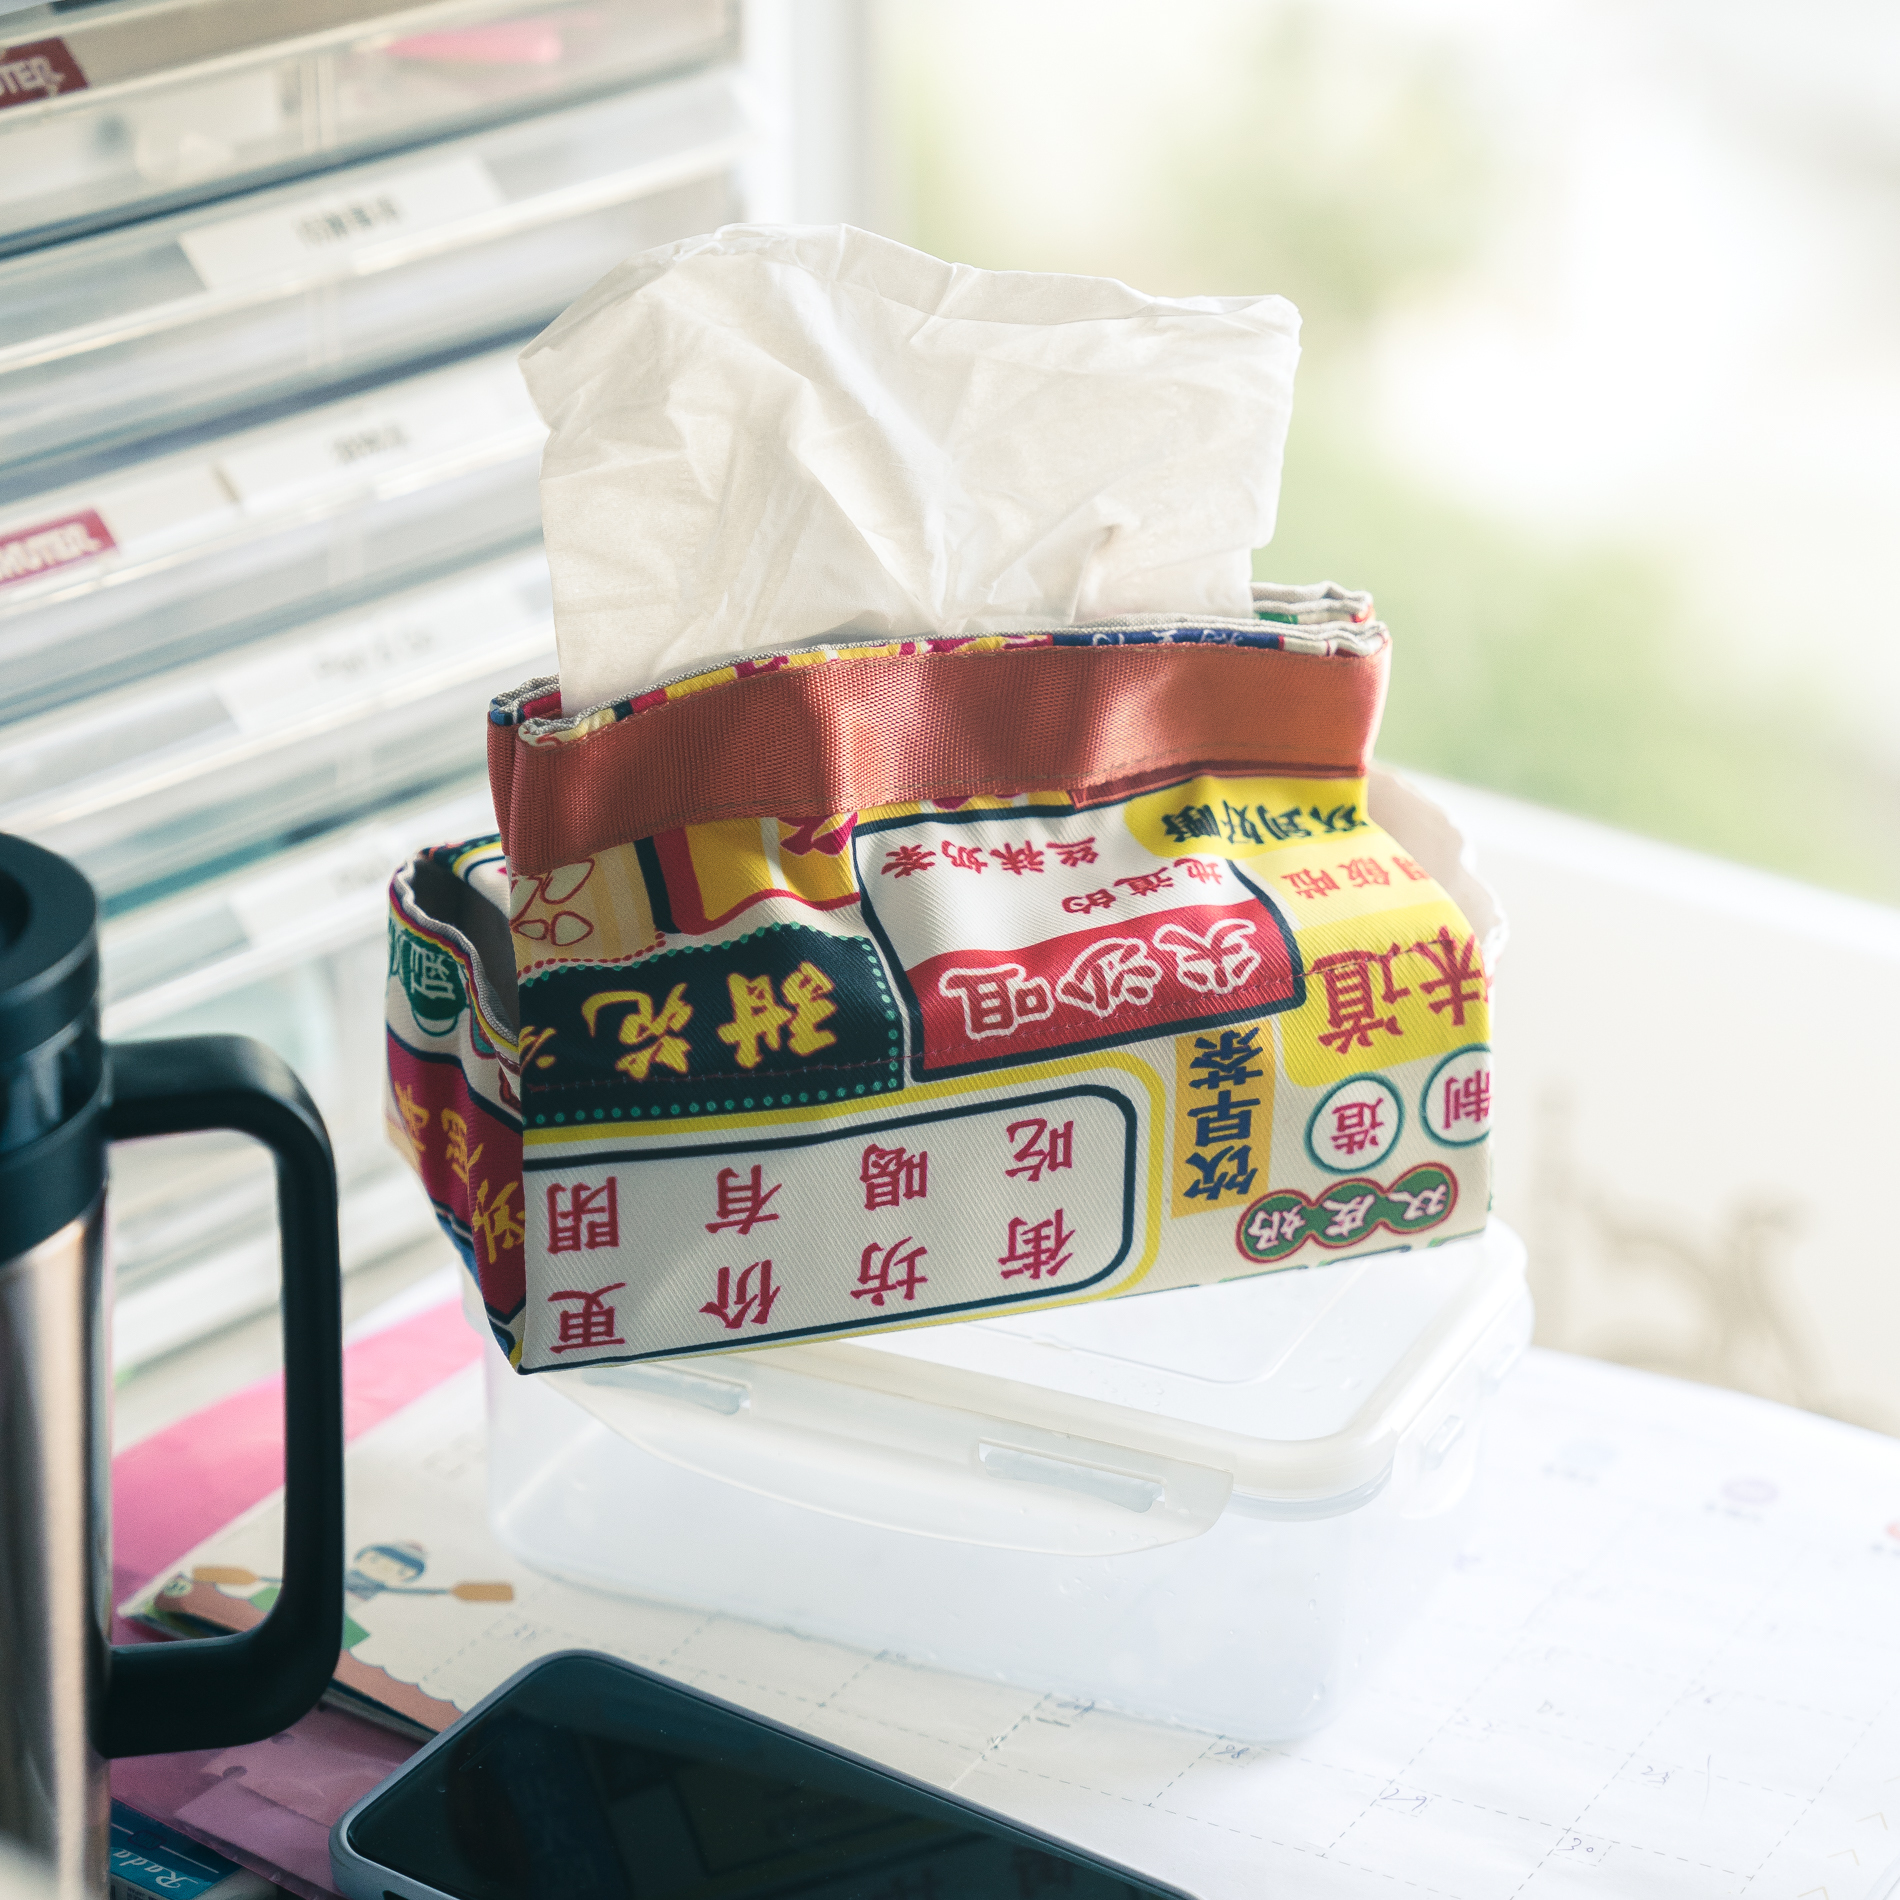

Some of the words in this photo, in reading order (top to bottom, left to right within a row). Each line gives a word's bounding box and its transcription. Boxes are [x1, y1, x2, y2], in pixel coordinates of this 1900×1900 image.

[880, 837, 1099, 878] 丝袜奶茶
[1061, 857, 1222, 914] 地道的
[938, 918, 1261, 1041] 尖沙咀
[1184, 1026, 1263, 1200] 饮早茶
[1247, 1184, 1449, 1251] 双皮奶
[1379, 1787, 1428, 1812] 29
[1555, 1837, 1595, 1853] 30
